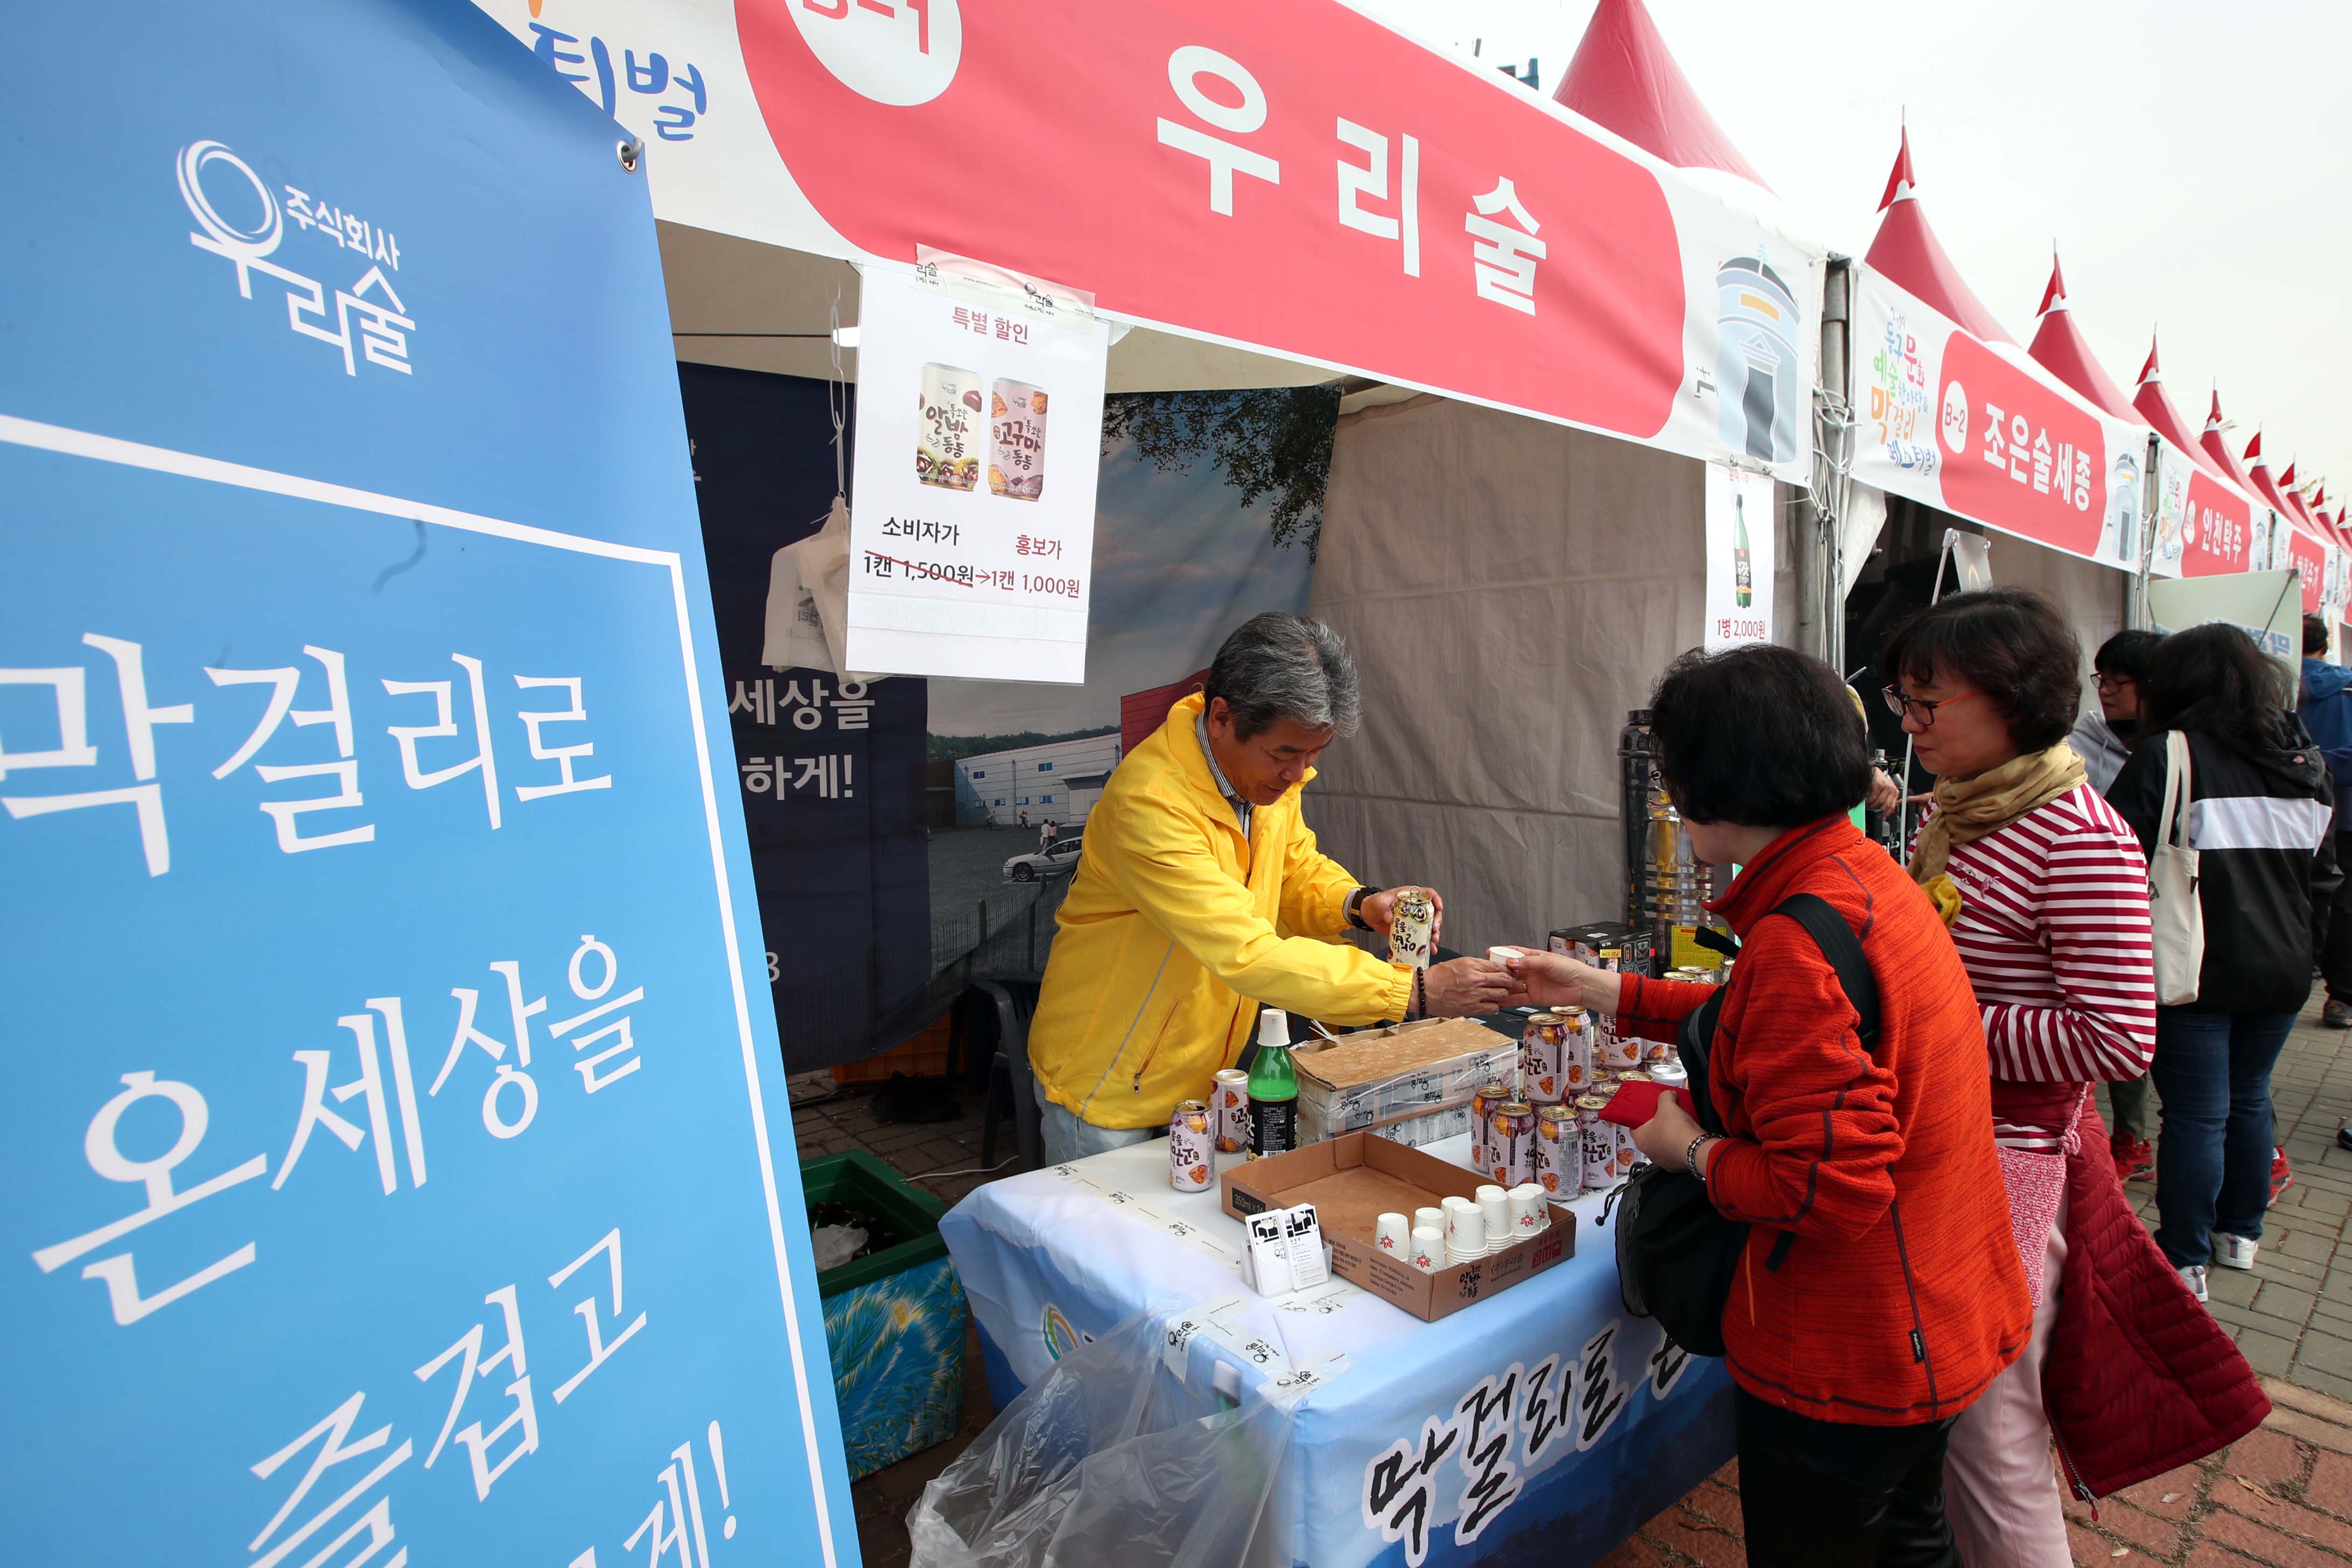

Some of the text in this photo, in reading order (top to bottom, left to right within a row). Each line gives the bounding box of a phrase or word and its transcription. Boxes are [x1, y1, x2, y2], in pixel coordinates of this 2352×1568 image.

[1158, 45, 1546, 316] 우리술
[285, 185, 401, 272] 주식회사
[177, 139, 416, 376] 우리술
[1024, 282, 1053, 308] 우리술
[952, 306, 1028, 345] 특별 할인
[1874, 348, 1899, 397] 예술
[1885, 321, 1925, 390] 동구 문화
[926, 405, 969, 440] 알밤
[999, 421, 1041, 452] 고구마
[1871, 386, 1916, 445] 막걸리
[942, 436, 965, 458] 동동
[1012, 449, 1033, 471] 동동
[1887, 439, 1936, 476] 페스티벌
[1944, 402, 2092, 512] B-2 조은술세종
[882, 517, 960, 546] 소비자가
[1015, 534, 1062, 560] 홍보가
[864, 556, 893, 578] 1캔
[902, 559, 974, 587] 1,500원
[1022, 576, 1080, 599] 1,000원
[1717, 618, 1766, 640] 1병 2,000원
[729, 678, 875, 730] 세상을
[0, 632, 612, 877] 막걸리로
[742, 754, 853, 801] 하게!
[248, 1227, 646, 1568] 즐겁고
[1370, 1328, 1623, 1555] 막걸리로
